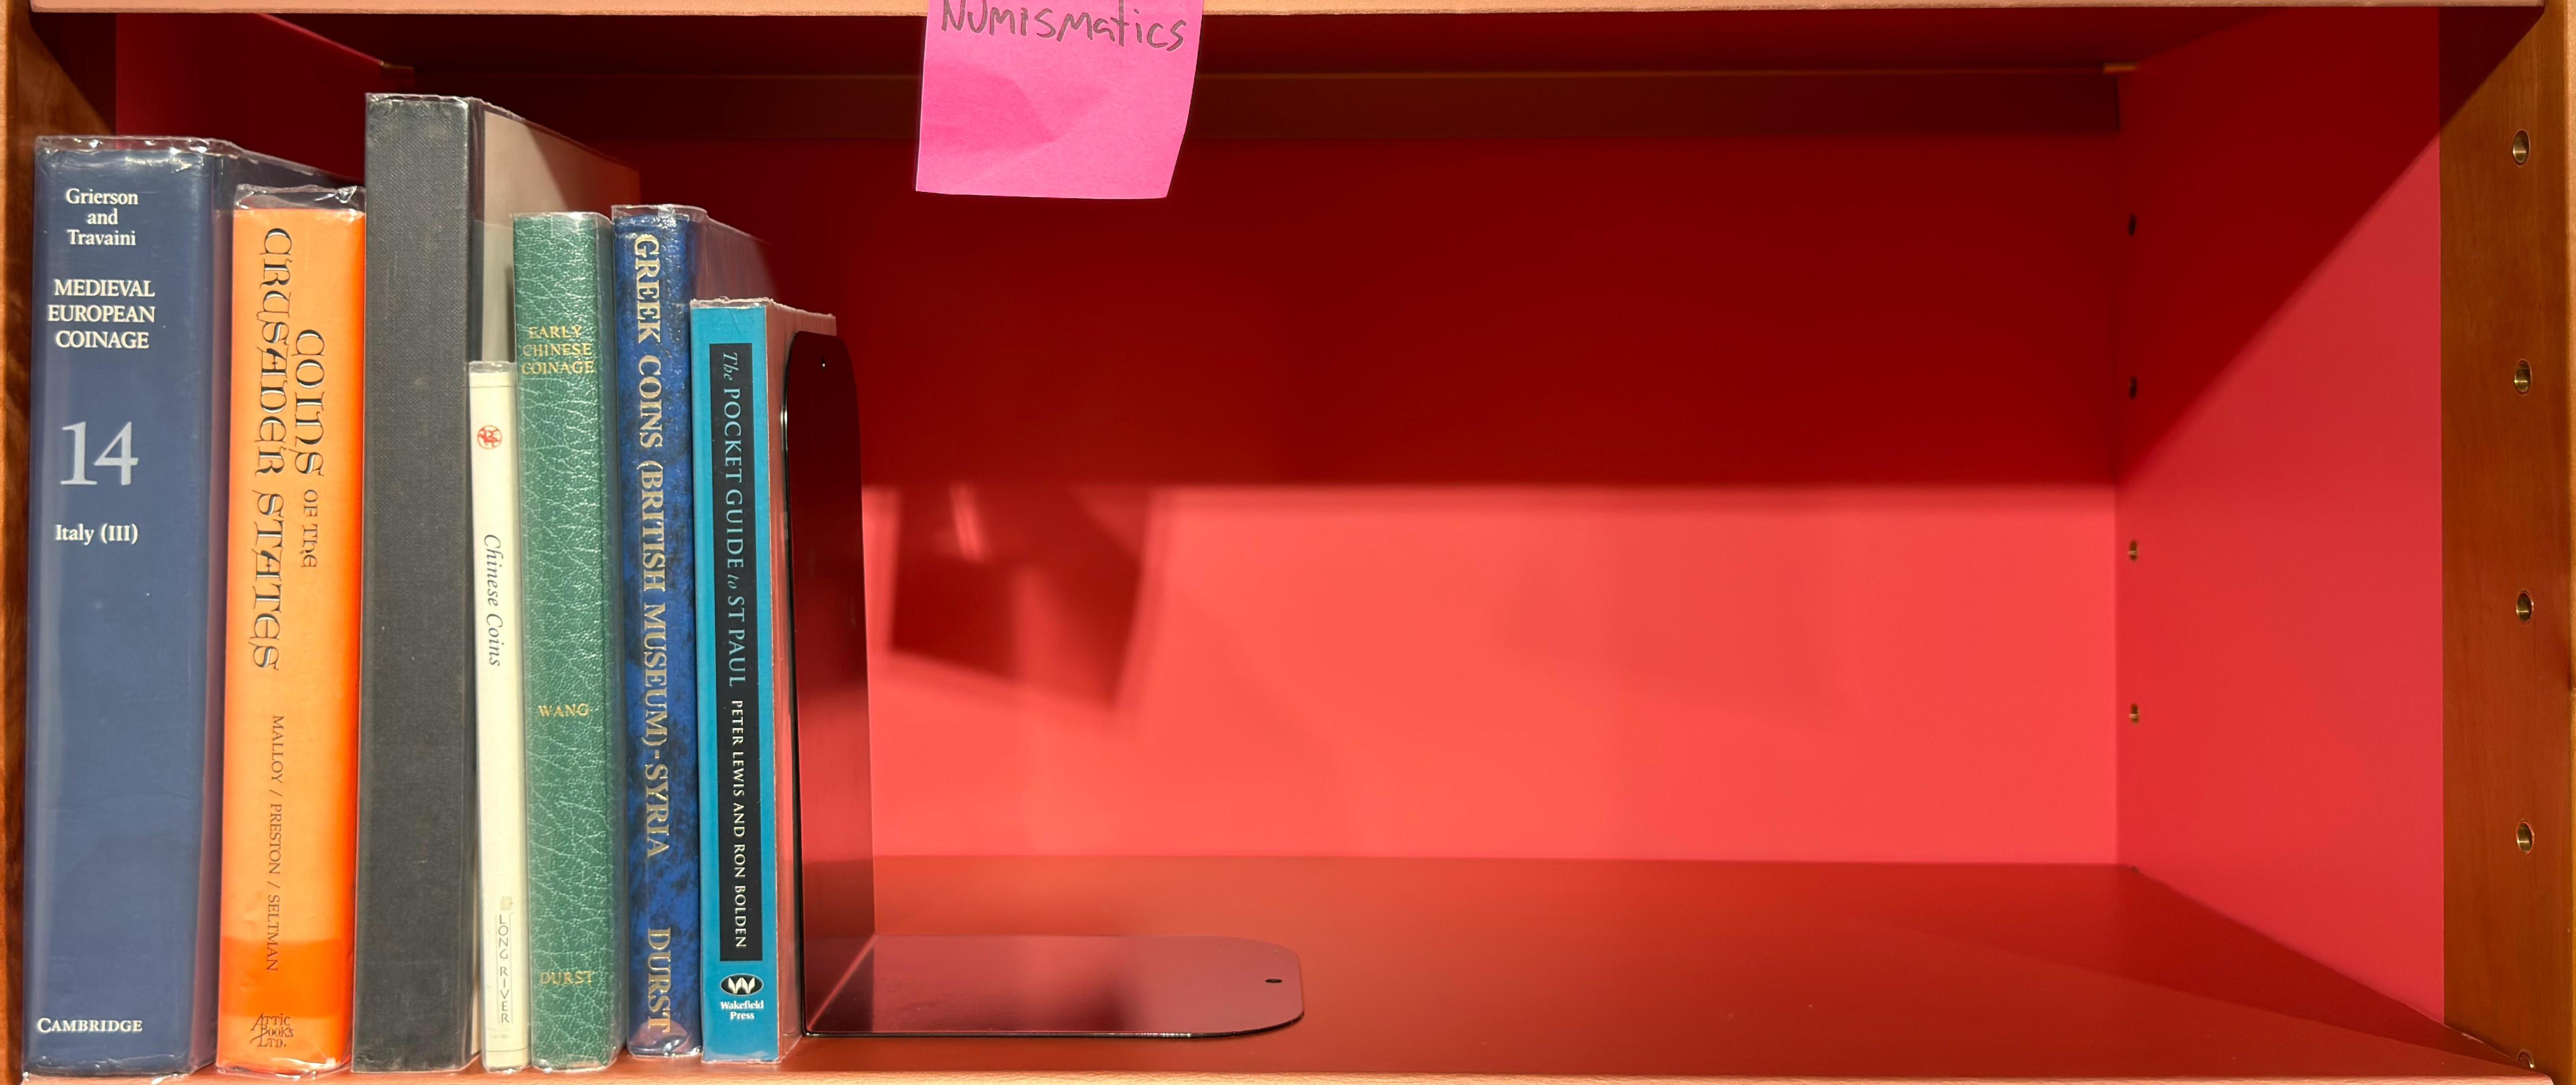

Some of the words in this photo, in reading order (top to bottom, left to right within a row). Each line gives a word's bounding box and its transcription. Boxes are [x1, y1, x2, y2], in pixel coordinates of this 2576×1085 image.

[65, 187, 139, 205] Grierson
[87, 208, 118, 225] and
[66, 229, 136, 246] Travaini
[53, 279, 156, 297] MEDIEVAL
[634, 234, 661, 344] GREEK
[47, 304, 156, 323] EUROPEAN
[529, 325, 582, 339] EARLY
[56, 330, 149, 349] COINAGE
[255, 228, 293, 477] CRUSADER
[523, 342, 593, 357] CHINESE
[521, 360, 595, 375] COINAGE
[723, 352, 739, 381] The
[289, 329, 325, 476] COINS
[638, 355, 664, 449] COINS
[60, 421, 139, 486] 14
[724, 387, 742, 483] POCKET
[304, 489, 318, 517] OF
[56, 523, 95, 546] Italy
[100, 523, 139, 545] (III)
[637, 460, 666, 593] (BRITISH
[726, 488, 744, 569] GUIDE
[249, 489, 284, 671] STATES
[484, 534, 504, 607] Chinese
[728, 574, 739, 590] to
[728, 596, 745, 623] ST
[486, 613, 505, 667] Coins
[729, 628, 746, 688] PAUL
[538, 703, 589, 717] WANG
[732, 700, 744, 746] PETER
[271, 715, 284, 784] MALLOY
[732, 751, 745, 797] LEWIS
[269, 803, 282, 875] PRESTON
[733, 802, 746, 838] AND
[734, 844, 746, 879] RON
[266, 894, 280, 972] SELTMAN
[498, 914, 509, 959] LONG
[735, 885, 747, 948] BOLDEN
[500, 966, 510, 1024] RIVER
[540, 970, 595, 985] DURST
[647, 927, 672, 1033] DURST
[720, 1000, 764, 1010] Wakefield
[730, 1011, 755, 1020] Press
